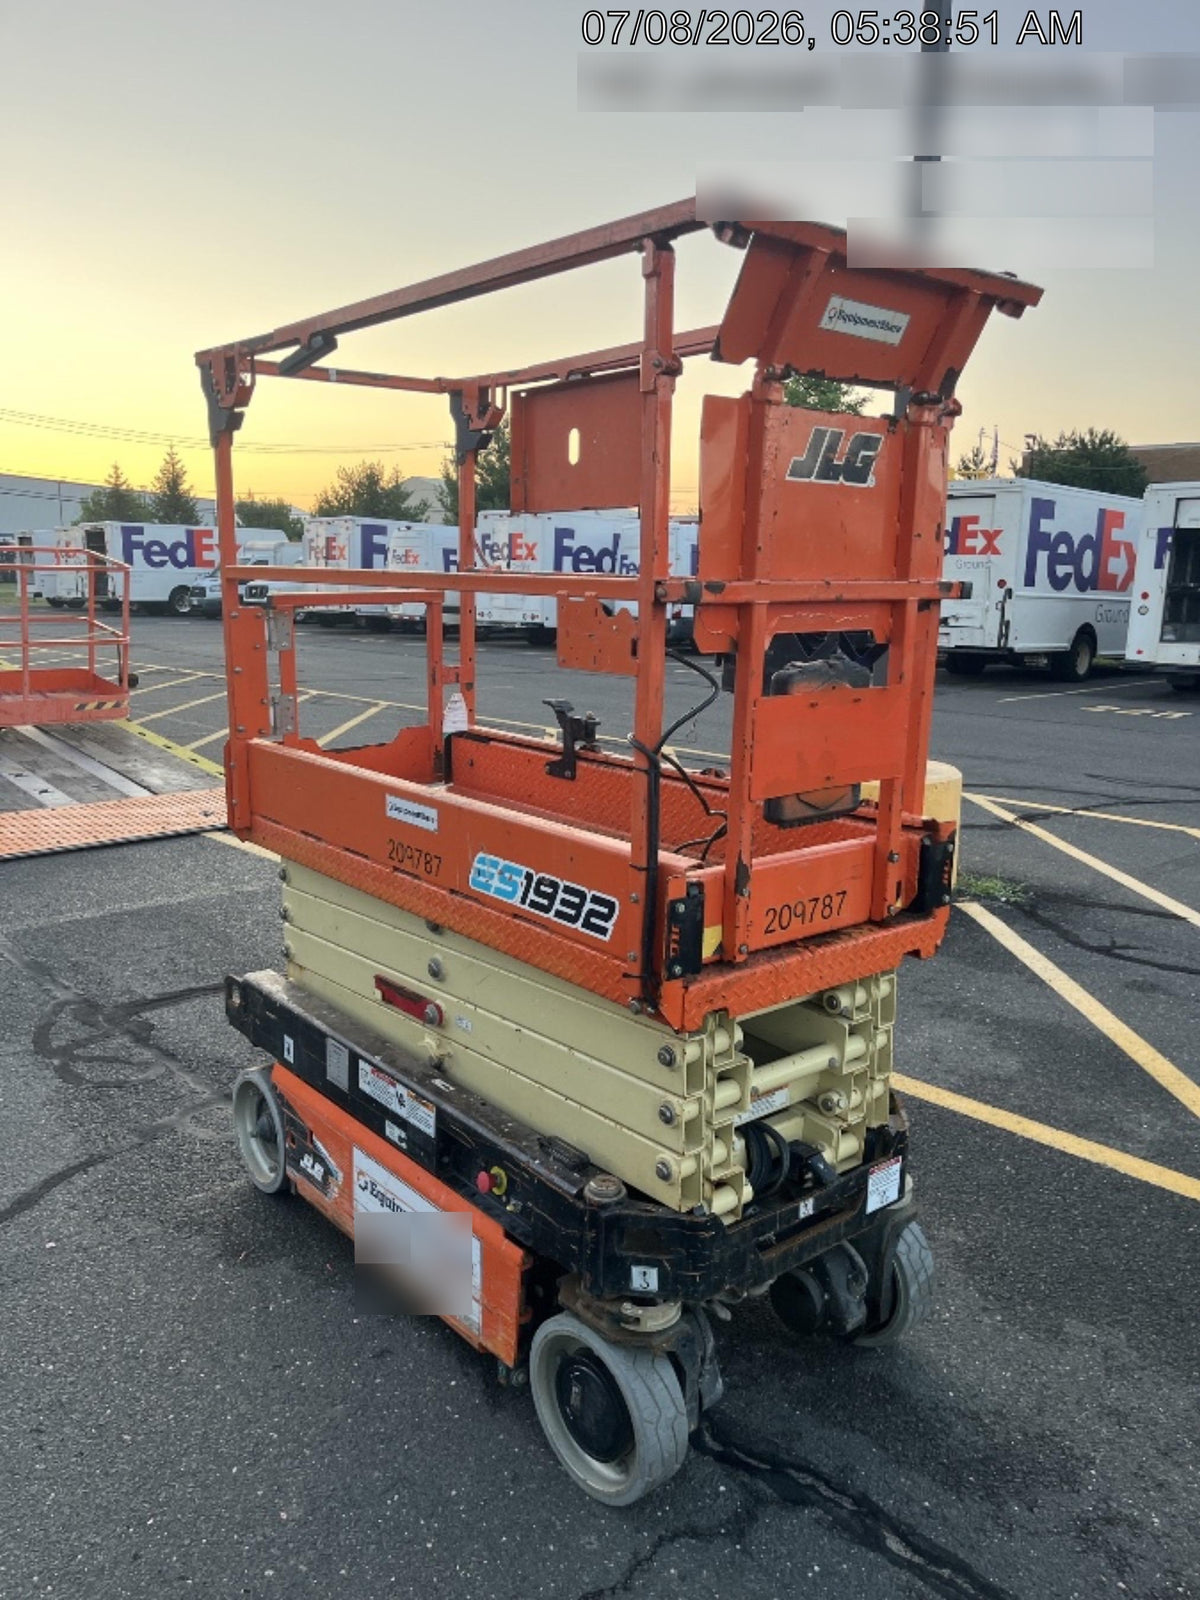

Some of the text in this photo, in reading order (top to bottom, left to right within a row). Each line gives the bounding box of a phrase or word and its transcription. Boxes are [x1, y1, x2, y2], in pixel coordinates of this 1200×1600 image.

[785, 426, 884, 487] JLG
[308, 536, 347, 560] FedEx
[481, 533, 538, 561] FedEx
[554, 528, 620, 573] Fed
[944, 515, 1003, 555] dEx
[392, 548, 420, 564] FedEx
[387, 838, 442, 877] 209787
[469, 851, 620, 942] ES1932
[763, 890, 847, 935] 209787
